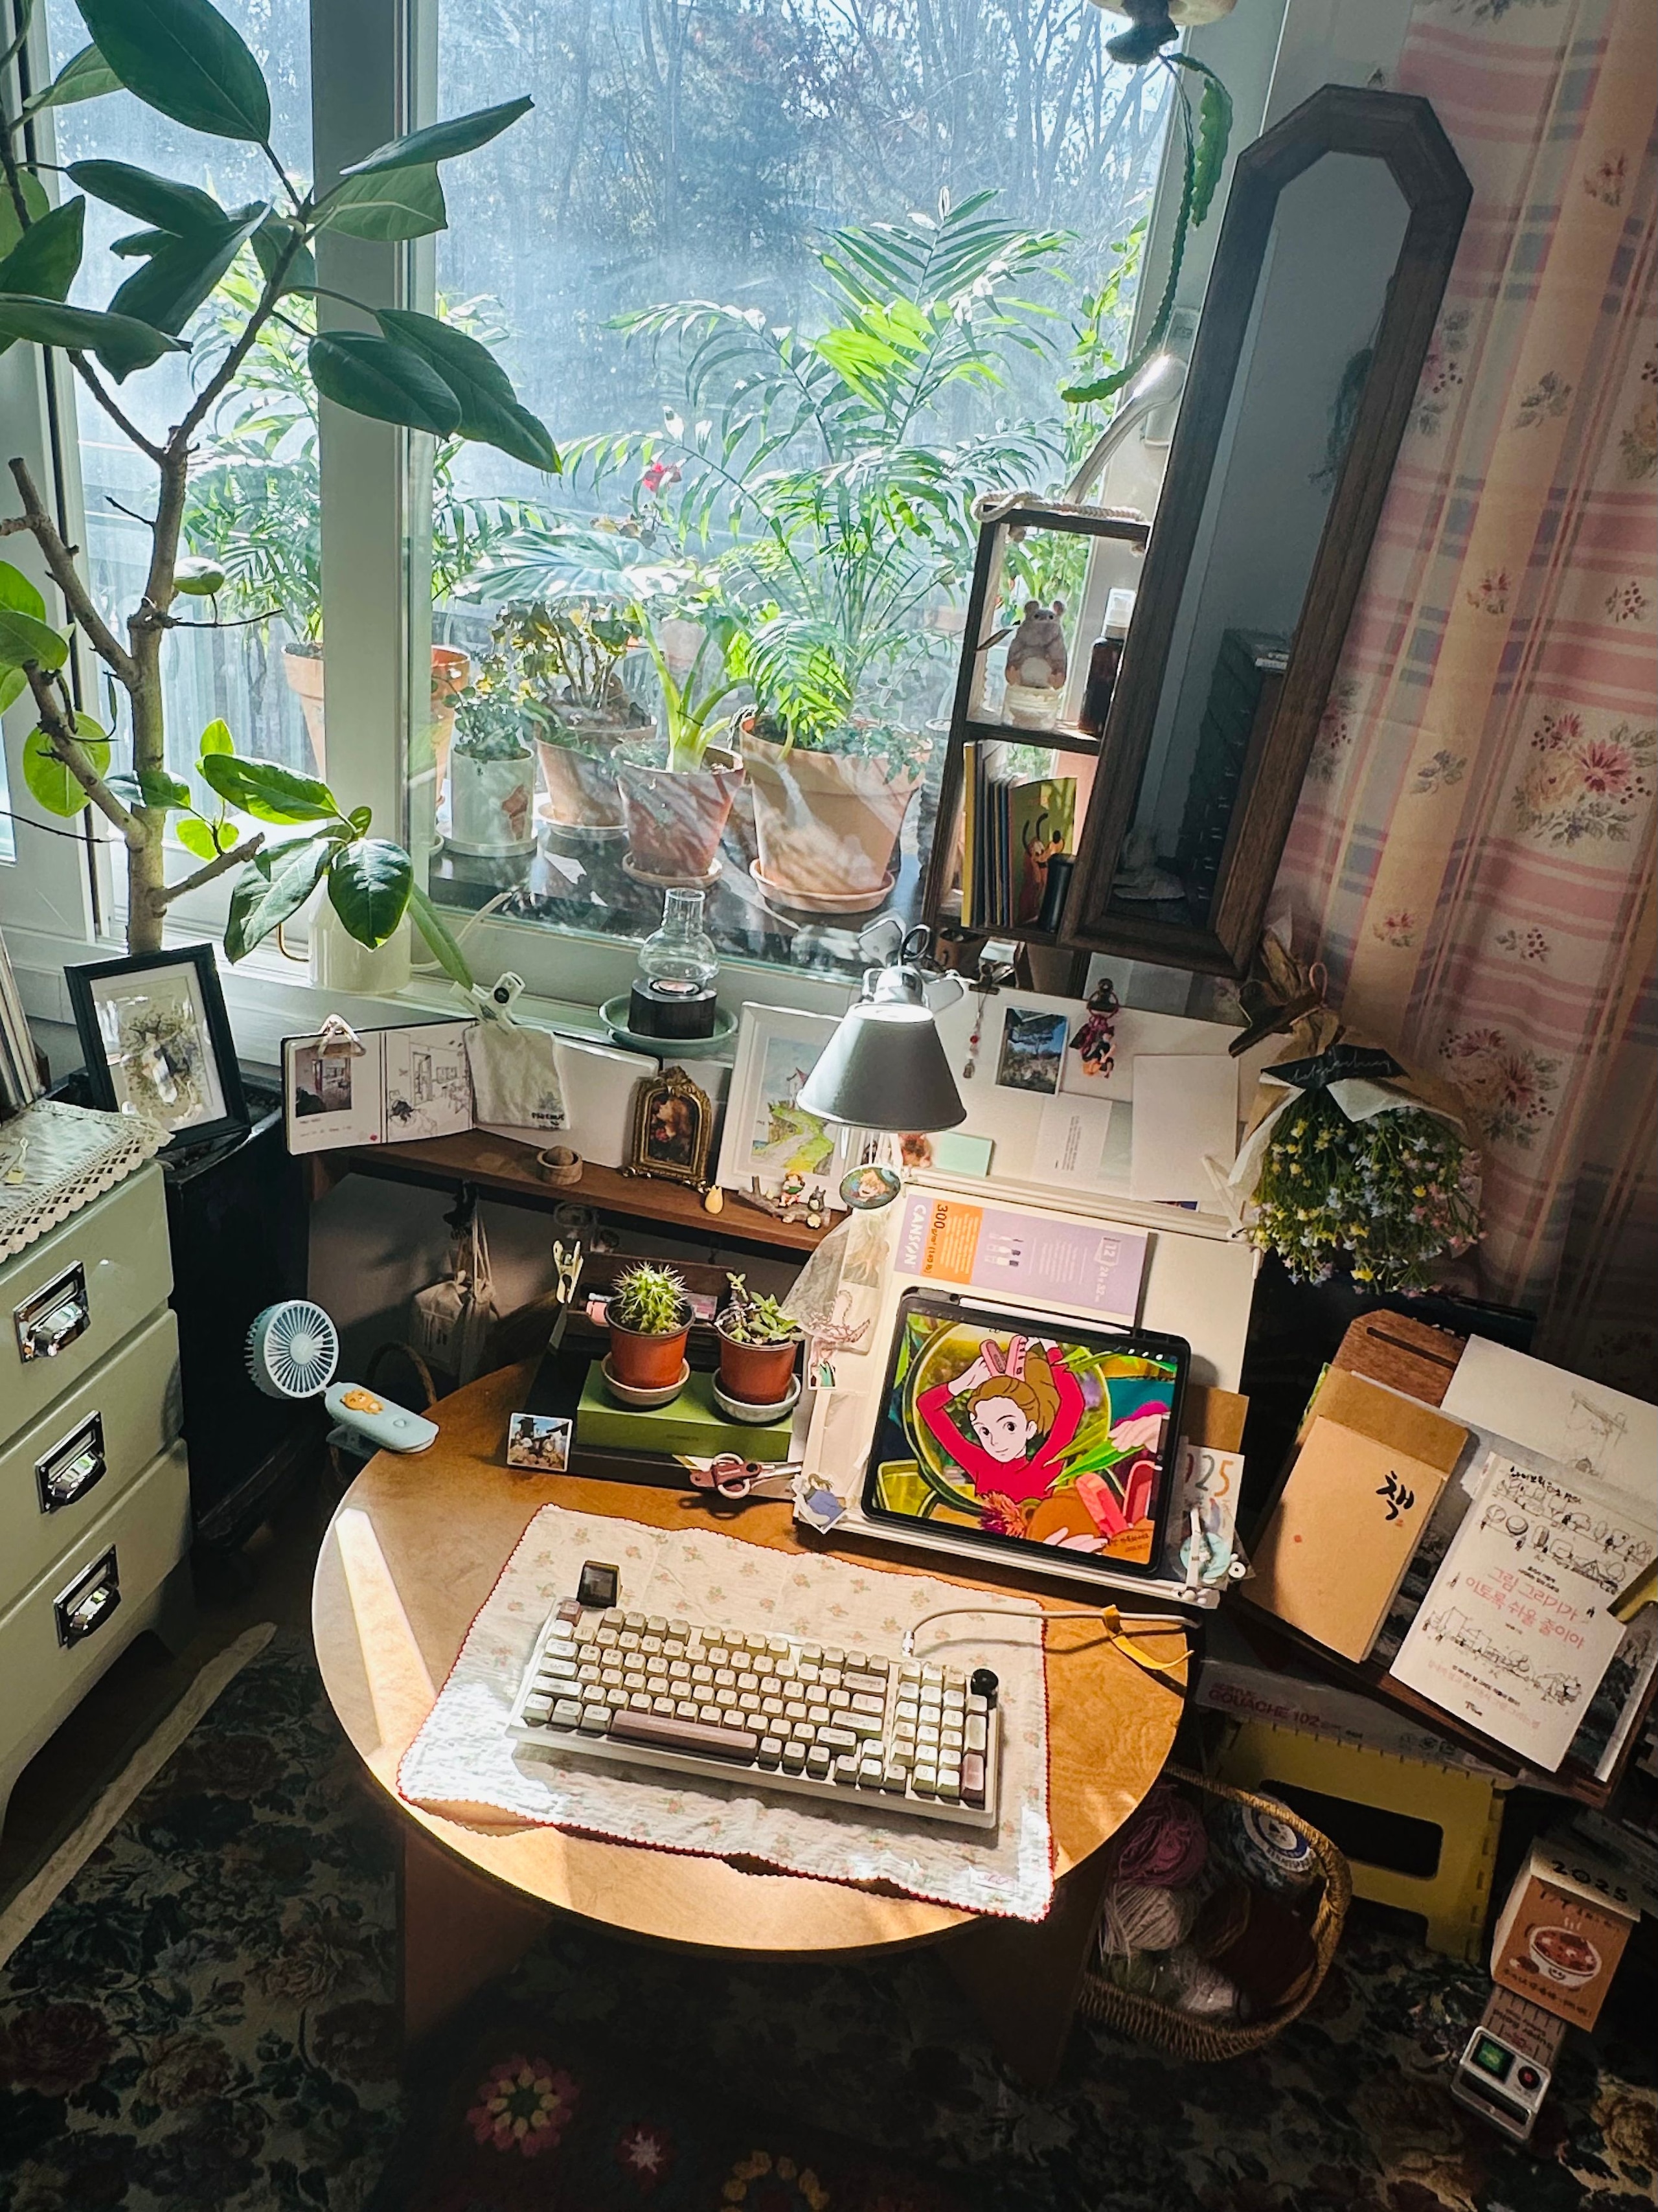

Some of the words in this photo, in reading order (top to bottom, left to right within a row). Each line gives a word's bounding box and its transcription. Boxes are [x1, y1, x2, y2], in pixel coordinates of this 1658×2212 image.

[903, 1203, 927, 1266] CANSON
[934, 1203, 949, 1229] 300
[1103, 1243, 1117, 1258] 12
[1376, 1471, 1414, 1520] 책
[1464, 1576, 1508, 1610] 이토록
[1506, 1600, 1538, 1626] 쉬울
[1538, 1617, 1586, 1650] 줄이야
[1488, 1566, 1517, 1592] 그림
[1519, 1584, 1579, 1621] 그리기가
[1209, 1689, 1290, 1718] GOUACHE
[1293, 1711, 1321, 1728] 102
[1551, 1859, 1628, 1903] 2025
